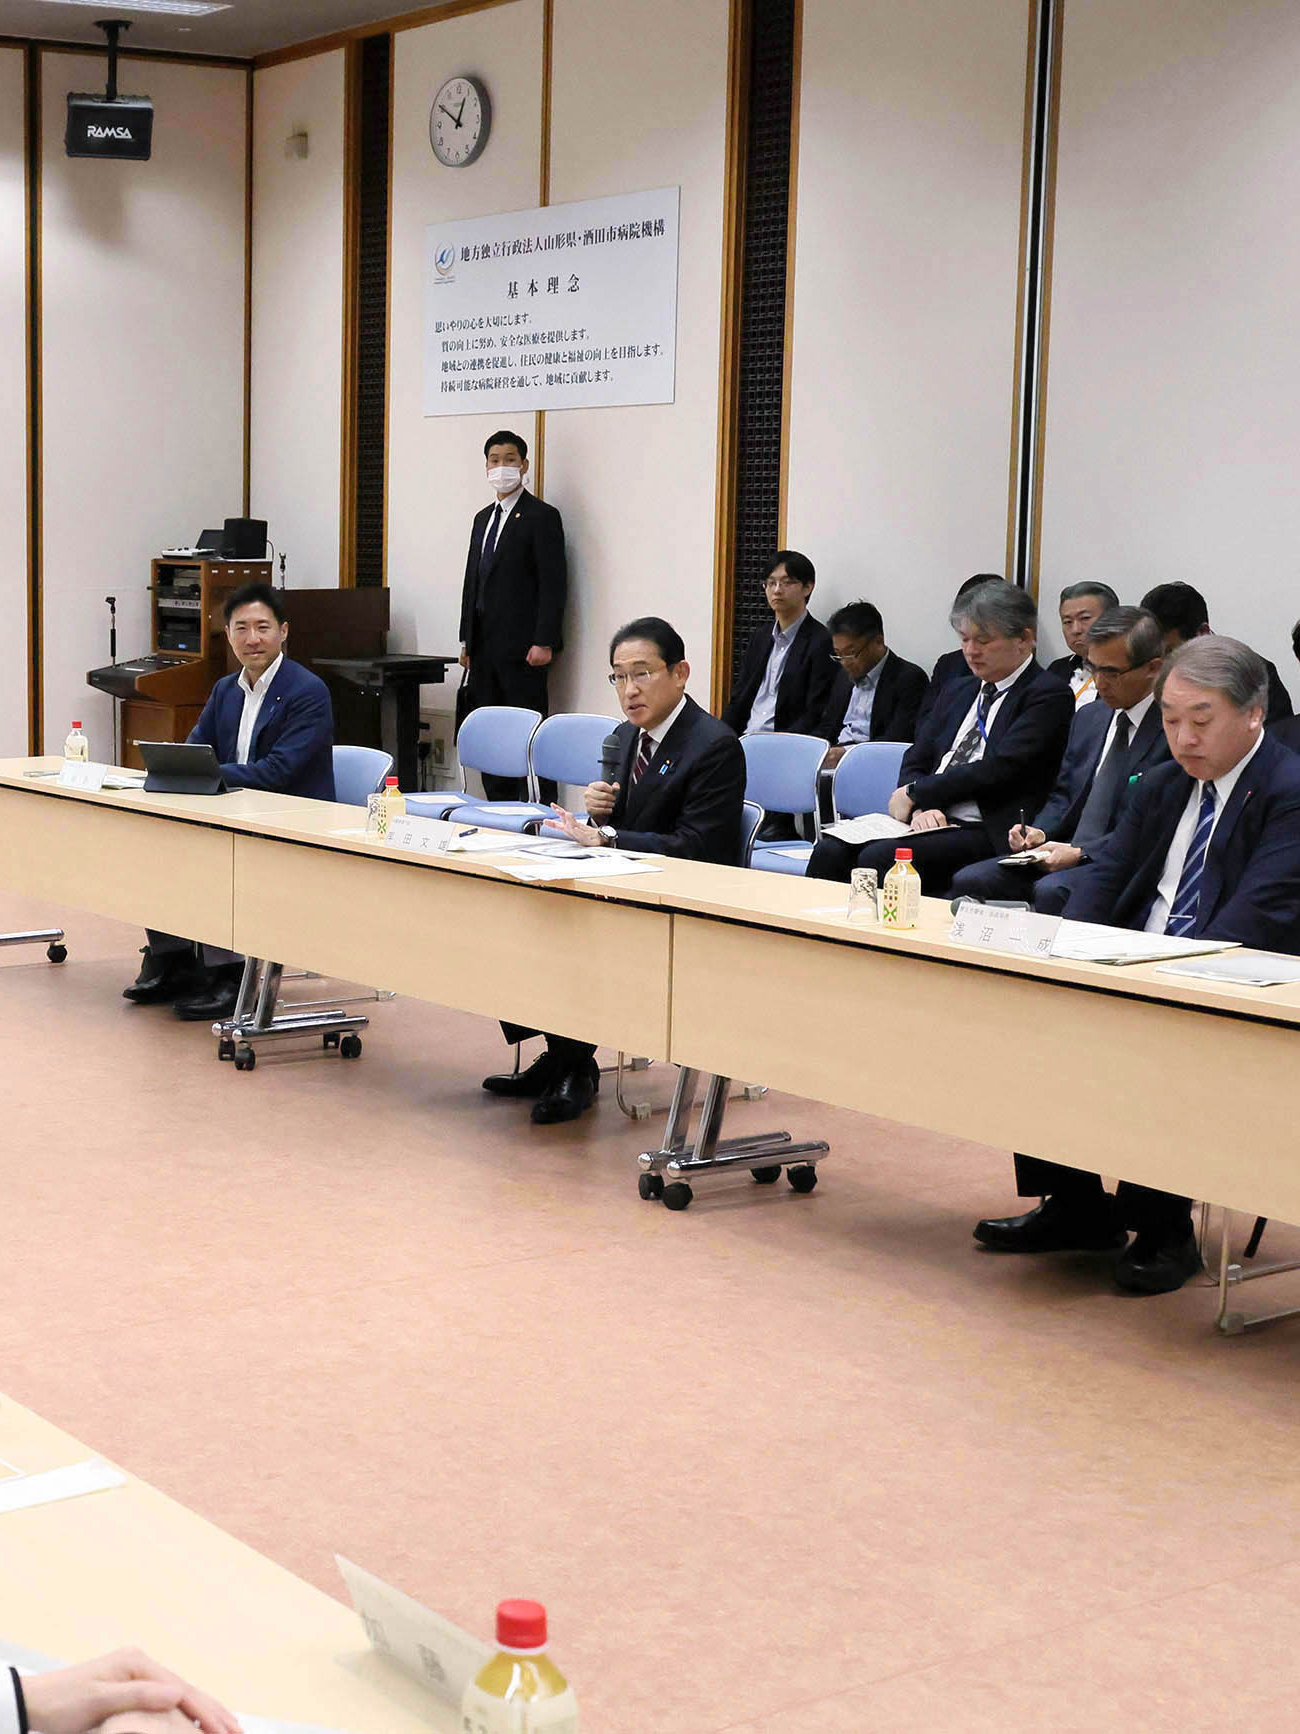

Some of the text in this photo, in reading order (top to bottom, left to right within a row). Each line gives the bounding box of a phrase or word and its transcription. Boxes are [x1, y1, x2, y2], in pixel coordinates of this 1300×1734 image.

[87, 125, 133, 139] RAMSA
[460, 218, 665, 262] 地方独立行政法人山形県・酒田市病院機構
[508, 273, 581, 299] 基本理念
[434, 312, 532, 333] 思いやりの心を大切にします。
[442, 328, 590, 352] 質の向上に努め、安全な医療を提供します。
[441, 343, 664, 373] 地域との連携を促進し、住民の健康と福祉の向上を目指します。
[440, 368, 614, 393] 持続可能な病院経営を通して、地域に貢献します。
